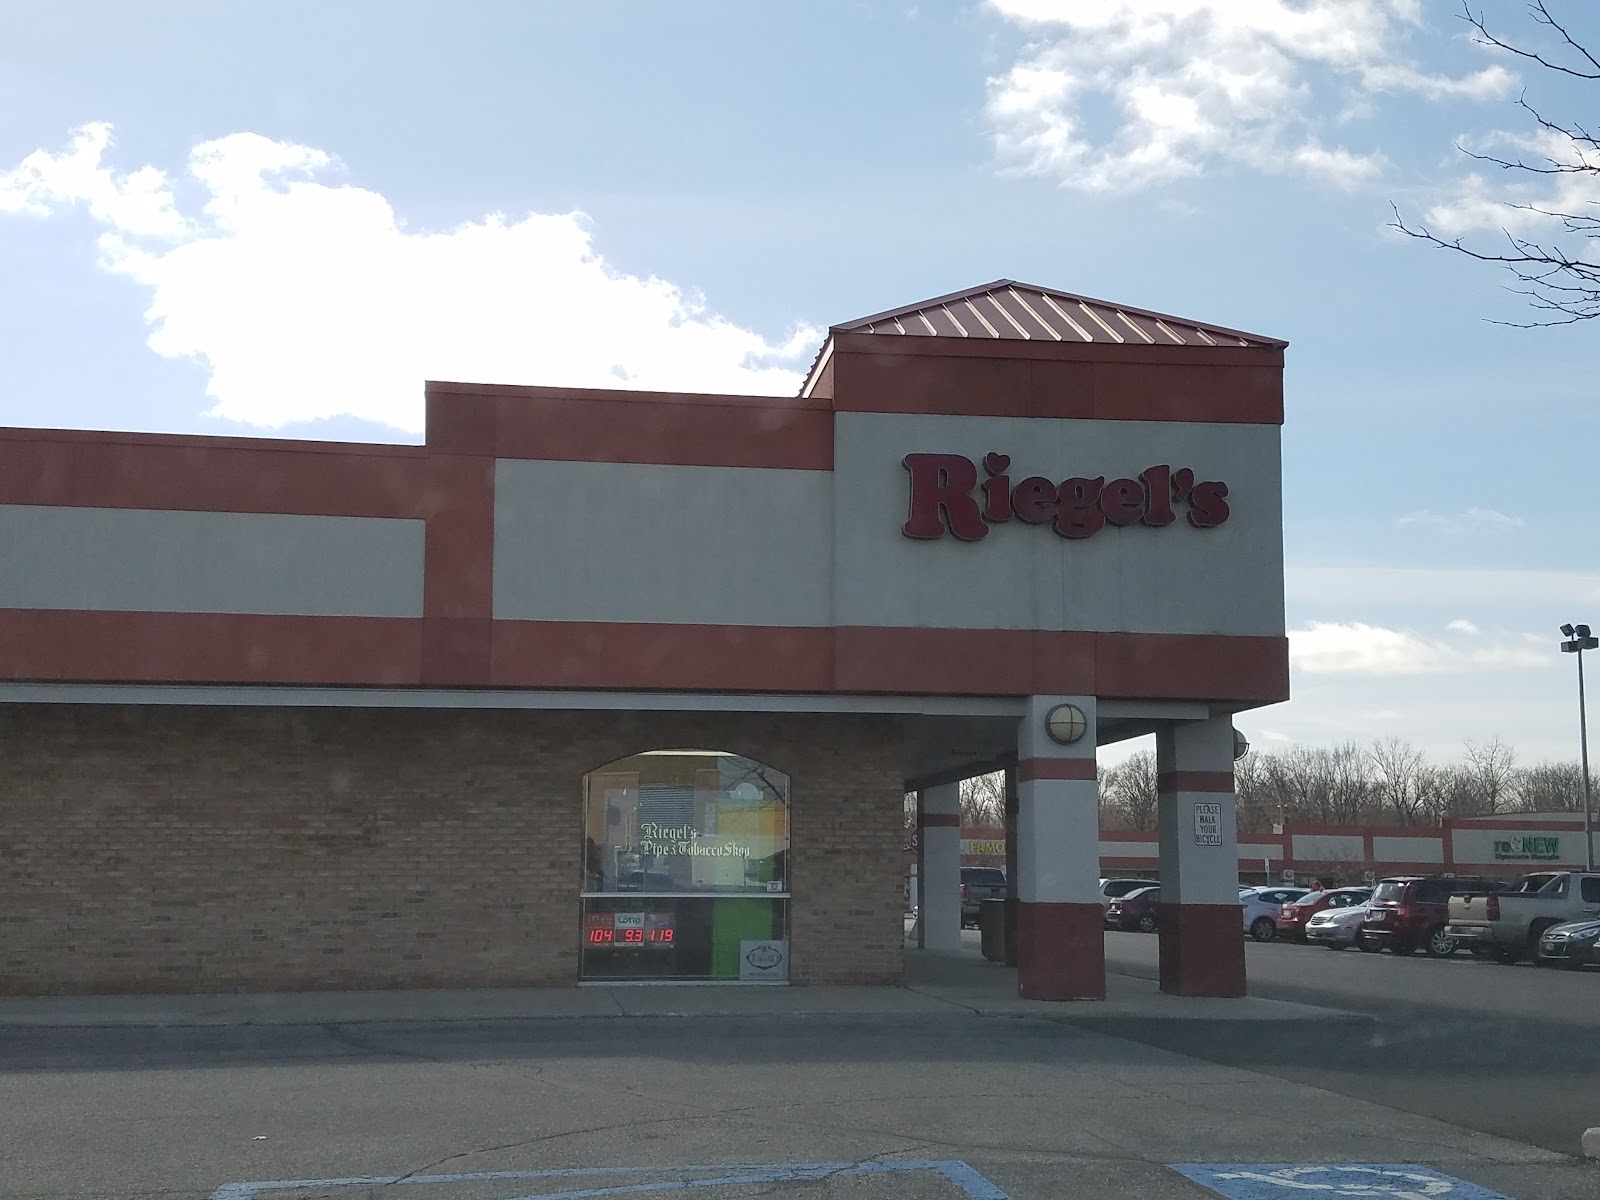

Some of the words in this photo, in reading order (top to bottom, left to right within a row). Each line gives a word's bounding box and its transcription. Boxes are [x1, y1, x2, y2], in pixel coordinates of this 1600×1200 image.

[901, 452, 1231, 541] Riegel's
[1195, 805, 1219, 815] PLEASE
[1199, 815, 1216, 824] WALK
[641, 822, 697, 843] Riegel's
[1200, 825, 1217, 834] YOUR
[1195, 834, 1221, 844] BICYCLE
[1522, 836, 1559, 853] NEW
[590, 929, 613, 942] 104
